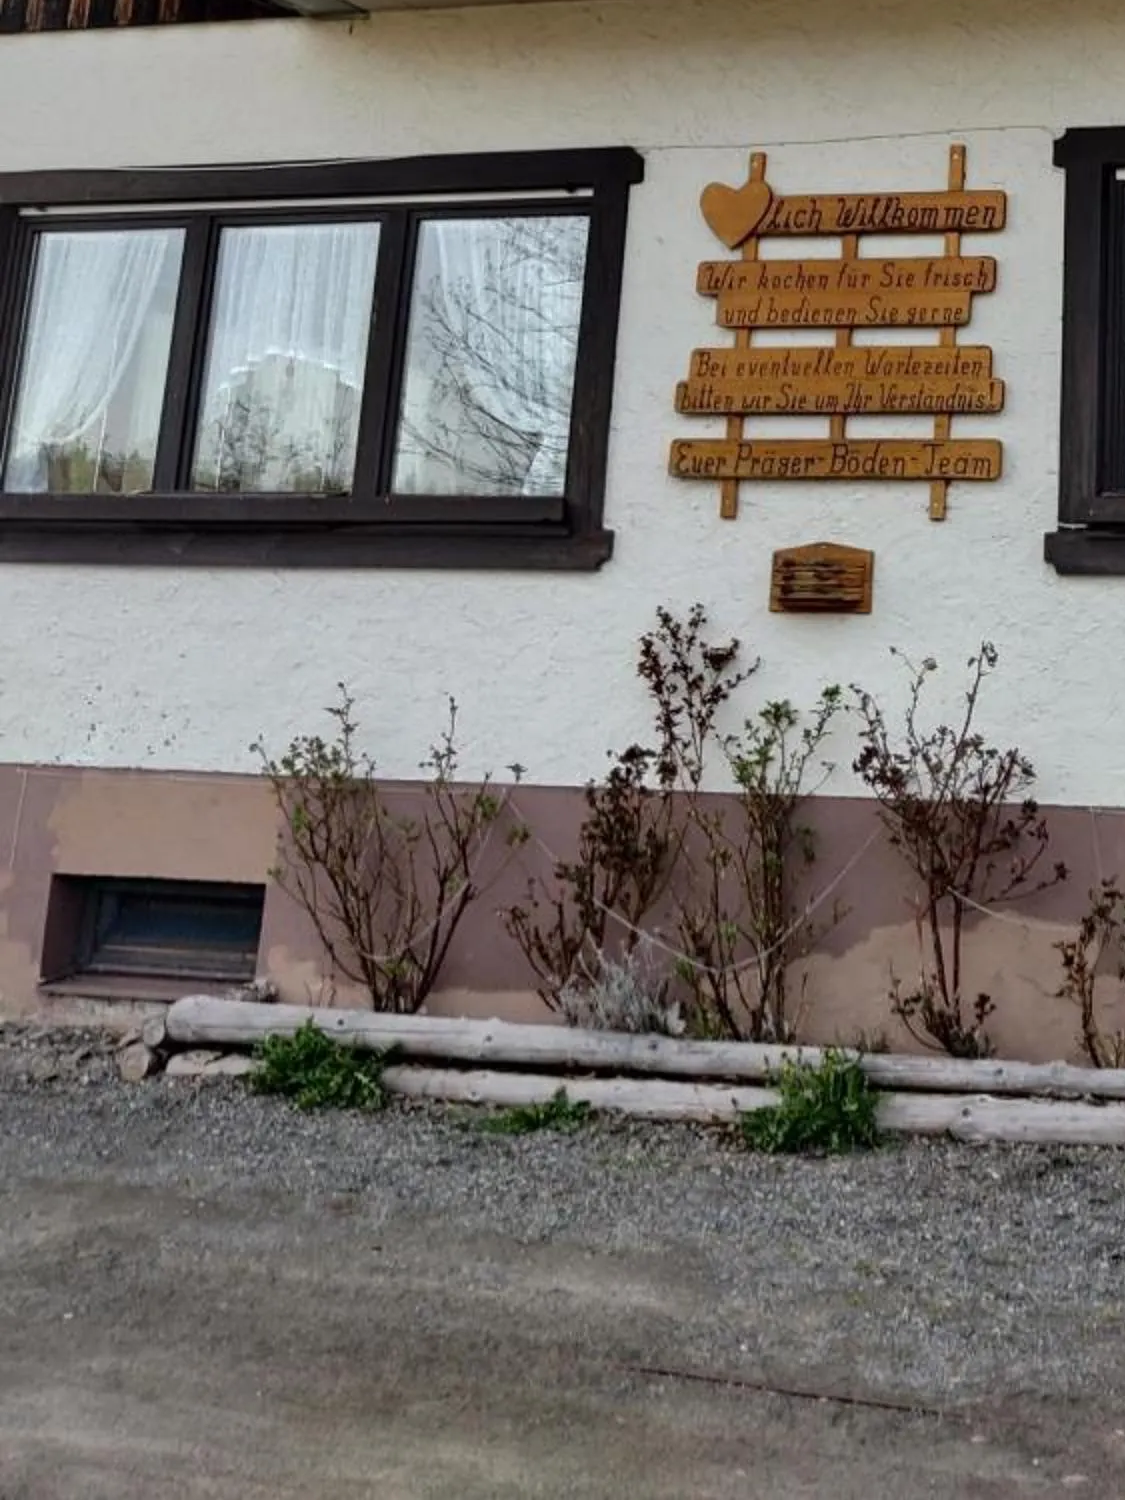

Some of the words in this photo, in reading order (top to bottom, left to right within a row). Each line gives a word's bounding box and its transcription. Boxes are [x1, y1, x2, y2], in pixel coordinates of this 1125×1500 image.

[835, 198, 998, 229] Willkommen
[705, 265, 747, 290] Wir
[757, 262, 829, 291] kochen
[835, 261, 871, 289] für
[880, 260, 914, 288] Sie
[923, 258, 990, 288] frisch
[723, 300, 760, 324] und
[766, 299, 857, 324] bedienen
[865, 295, 900, 323] Sie
[906, 304, 964, 323] gerne
[696, 351, 727, 378] Bei
[735, 351, 857, 378] eventuellen
[865, 349, 984, 377] Wartezeiten
[680, 382, 734, 412] bitten
[740, 387, 771, 411] wir
[775, 380, 808, 410] Sie
[814, 391, 840, 411] um
[843, 382, 873, 411] Ihr
[879, 381, 997, 411] Verständnis!
[675, 443, 728, 476] Euer
